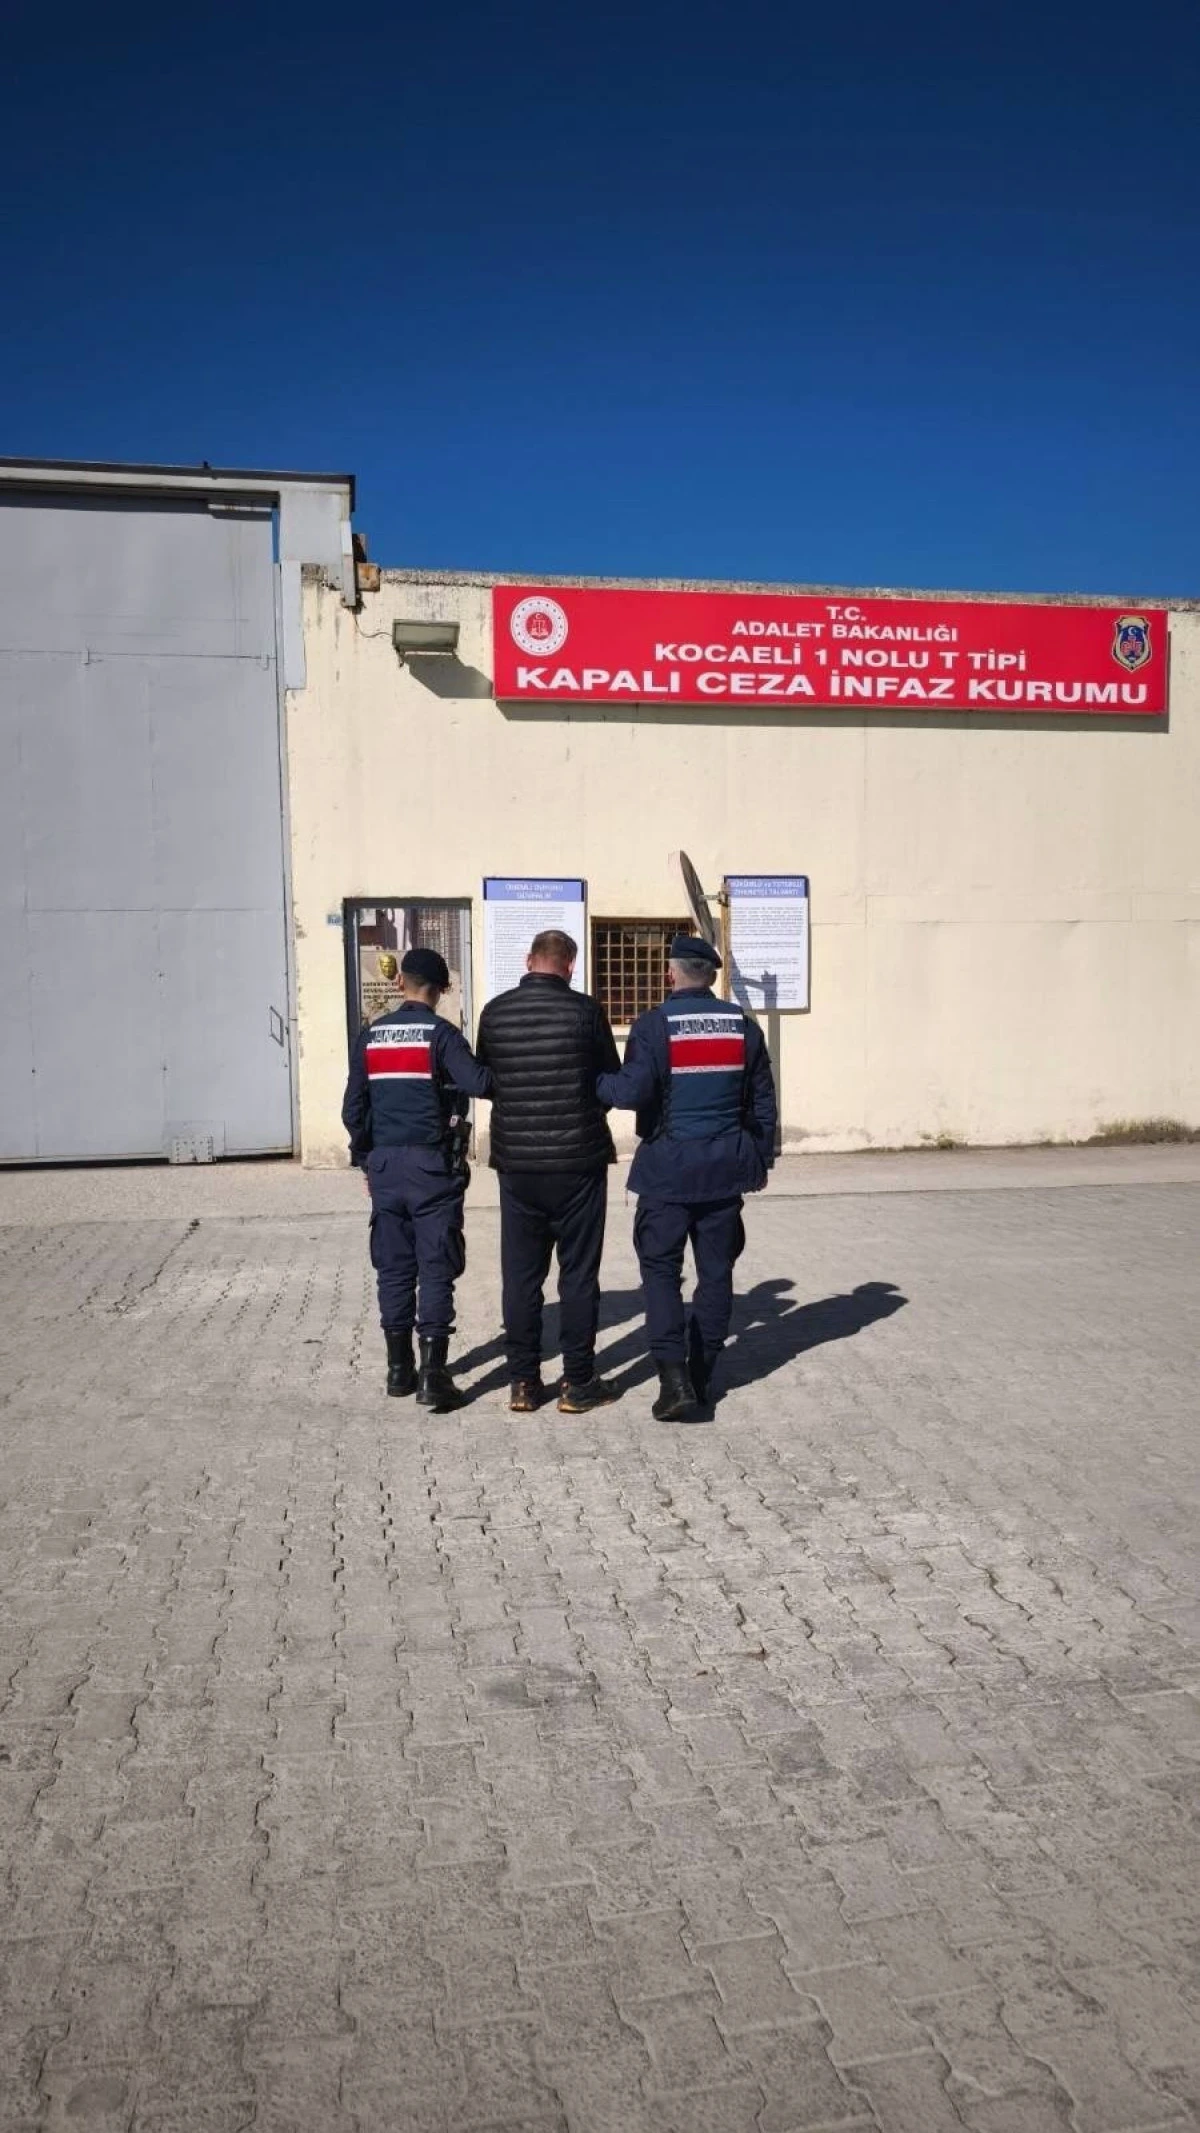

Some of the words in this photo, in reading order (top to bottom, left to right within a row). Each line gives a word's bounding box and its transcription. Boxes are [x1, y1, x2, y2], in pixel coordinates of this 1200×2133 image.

[826, 606, 867, 621] T.C.
[731, 621, 825, 638] ADALET
[831, 624, 958, 642] BAKANLIĞI
[655, 643, 802, 665] KOCAELİ
[814, 649, 829, 666] 1
[841, 650, 930, 669] NOLU
[939, 652, 959, 669] T
[967, 651, 1027, 671] TİPİ
[517, 666, 680, 694] KAPALI
[696, 671, 816, 697] CEZA
[829, 669, 955, 699] İNFAZ
[968, 678, 1148, 704] KURUMU
[677, 1018, 738, 1035] JANDARMA
